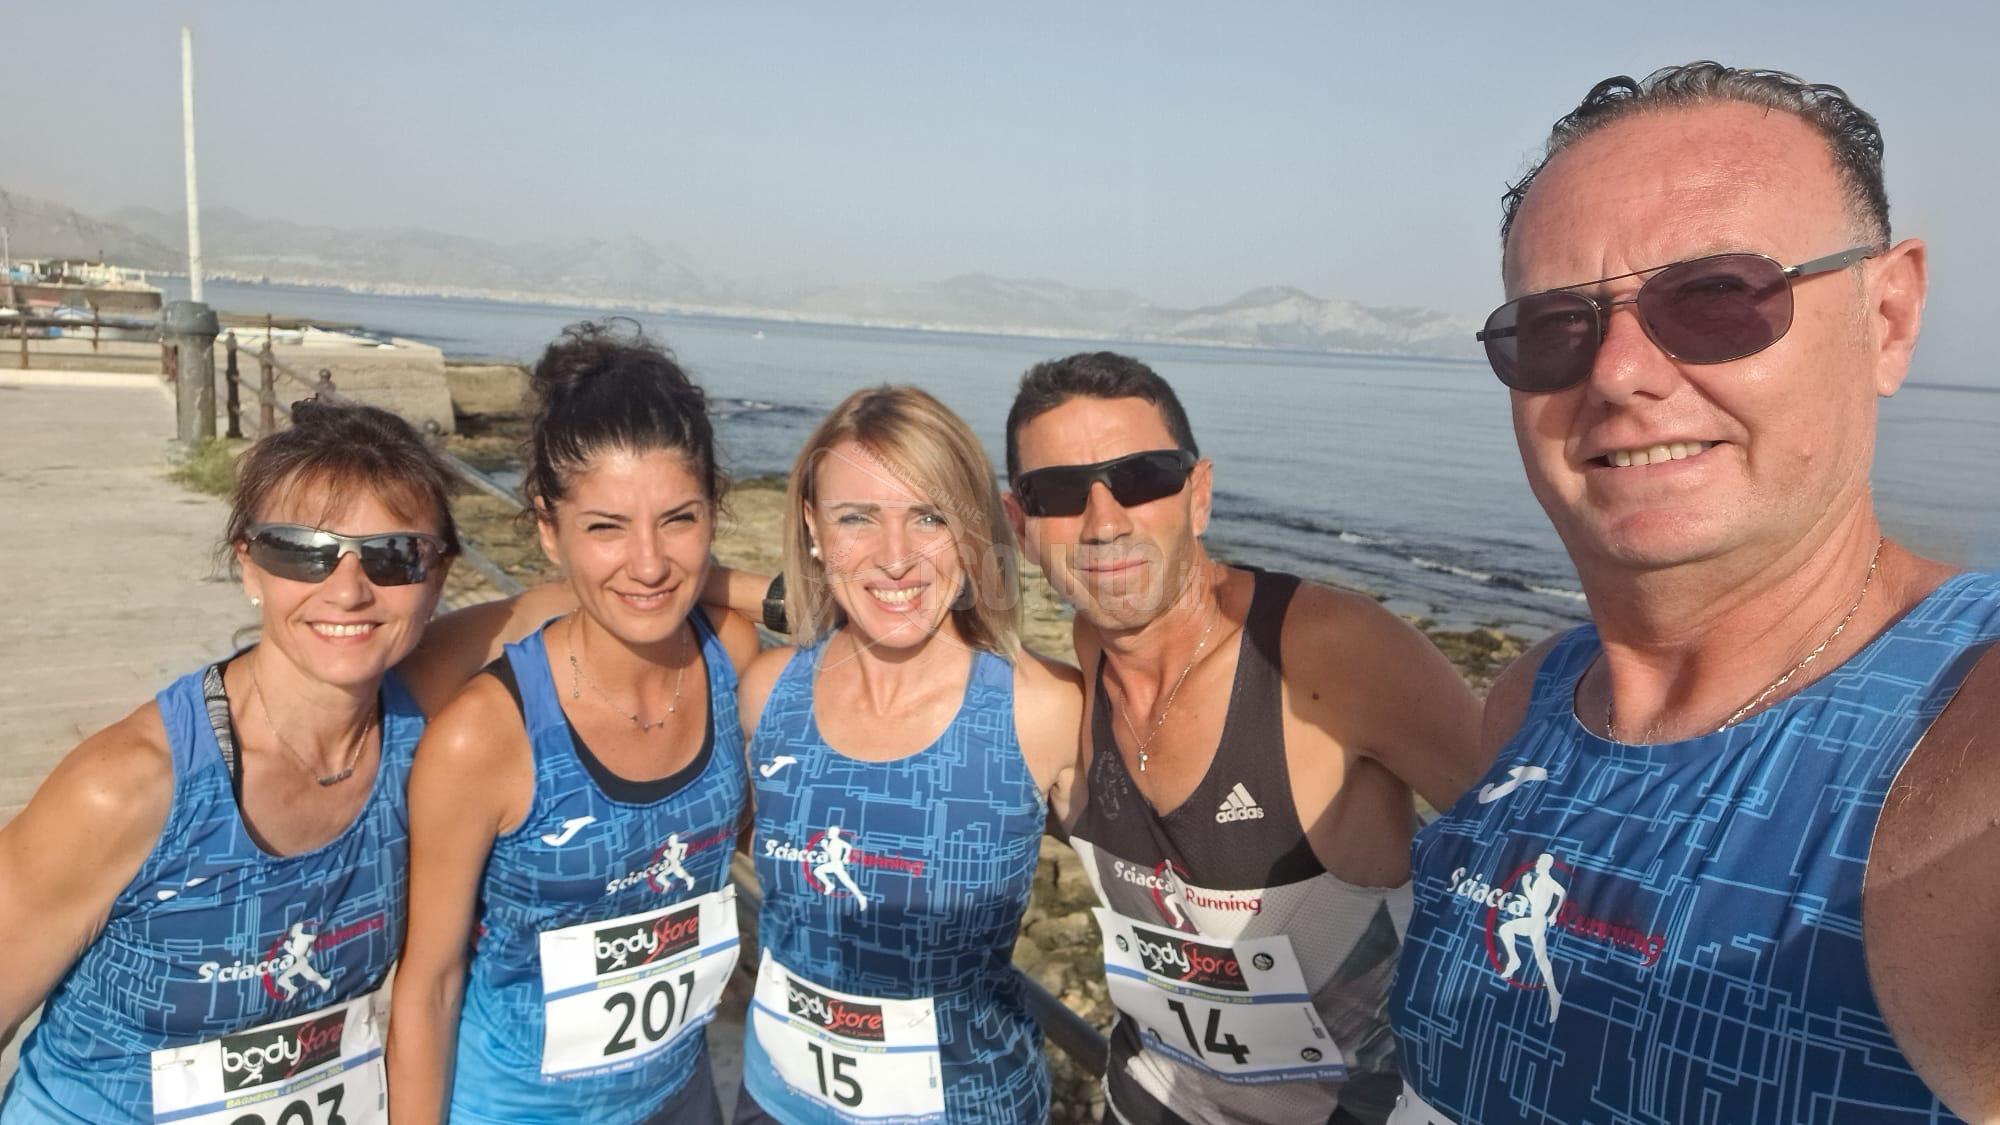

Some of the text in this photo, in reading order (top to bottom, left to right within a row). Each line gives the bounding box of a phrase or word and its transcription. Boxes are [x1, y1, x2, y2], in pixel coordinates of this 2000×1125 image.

[1215, 806, 1265, 824] adidas
[765, 839, 829, 864] Sciacca
[606, 859, 671, 896] Sciacca
[1114, 860, 1262, 917] Sciacca Running
[1446, 867, 1530, 917] Sciacca
[198, 954, 295, 984] Sciacca
[1168, 999, 1250, 1065] 14
[808, 1041, 864, 1108] 15
